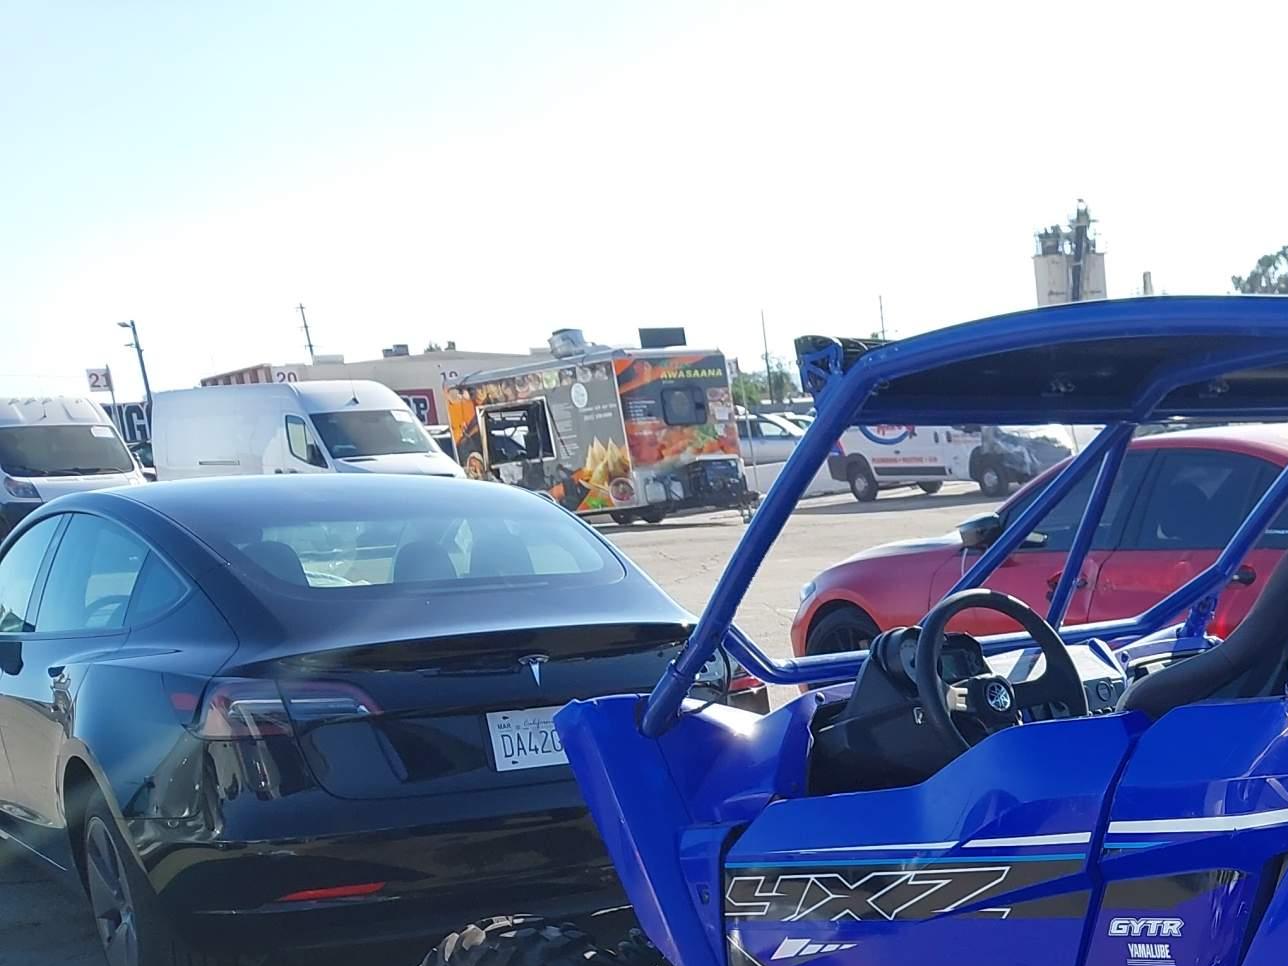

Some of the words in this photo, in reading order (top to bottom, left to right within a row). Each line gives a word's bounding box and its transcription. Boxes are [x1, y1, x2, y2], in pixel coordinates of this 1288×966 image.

[89, 373, 110, 388] 21
[725, 866, 1011, 921] YXZ
[1108, 917, 1184, 936] GYTR
[1127, 943, 1171, 959] YAMALUBE
